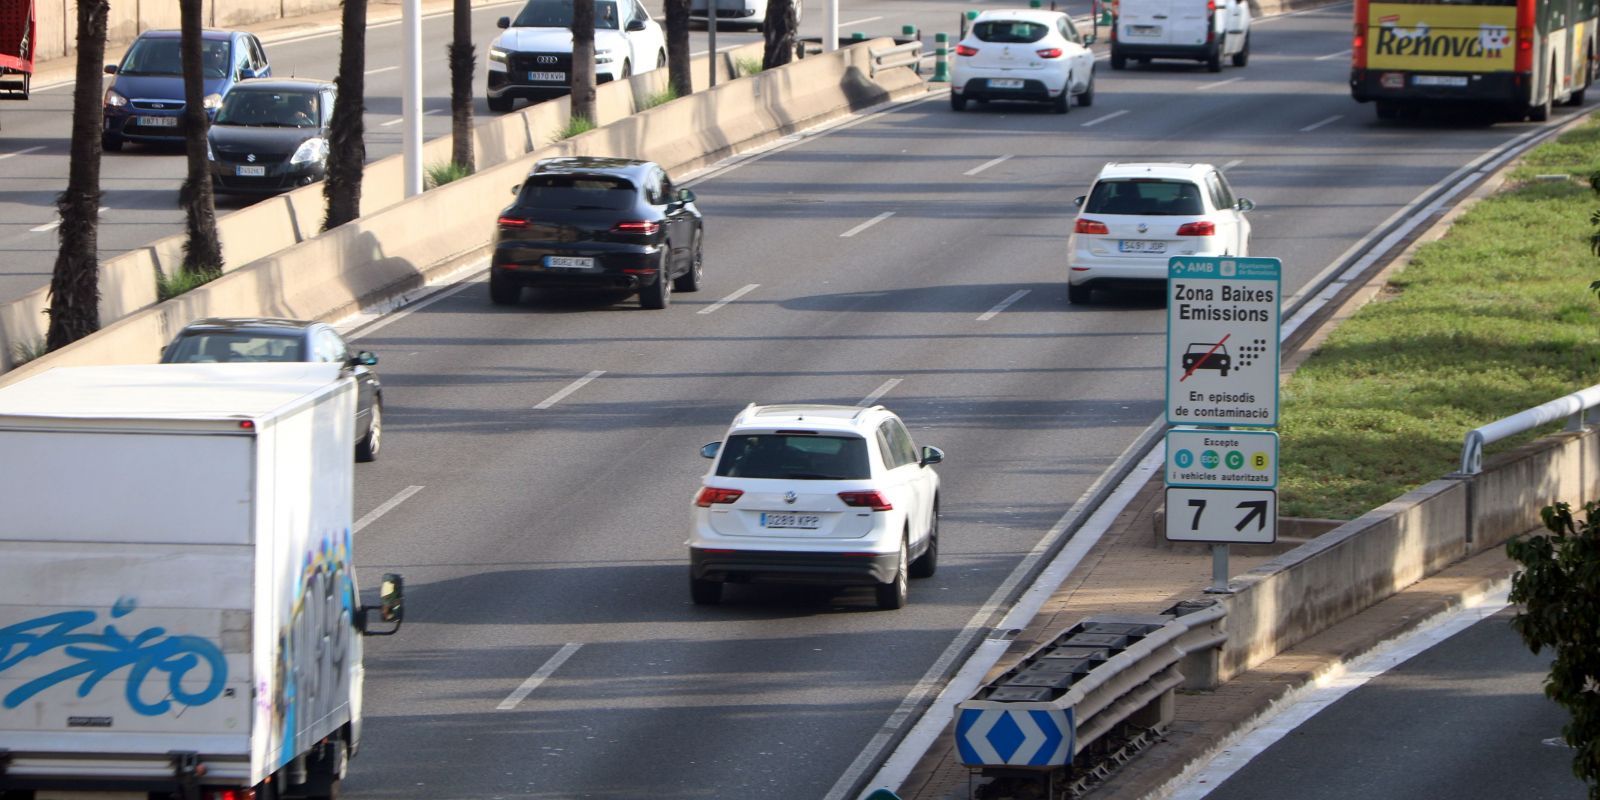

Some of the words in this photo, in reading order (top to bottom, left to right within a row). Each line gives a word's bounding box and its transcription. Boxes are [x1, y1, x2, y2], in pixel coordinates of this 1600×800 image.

[1376, 26, 1483, 57] Renova
[1187, 262, 1214, 273] AMB
[1175, 284, 1213, 301] Zona
[1221, 285, 1274, 303] Baixes
[1179, 304, 1269, 322] Emissions
[1189, 391, 1204, 402] En
[1208, 392, 1256, 405] episodis
[1175, 406, 1189, 417] de
[1194, 407, 1269, 419] contaminació
[1204, 438, 1239, 447] Excepte
[1229, 455, 1240, 466] C
[1255, 456, 1265, 466] B
[1180, 472, 1217, 481] vehicles
[1221, 474, 1269, 482] autoritzats
[1188, 499, 1207, 531] 7
